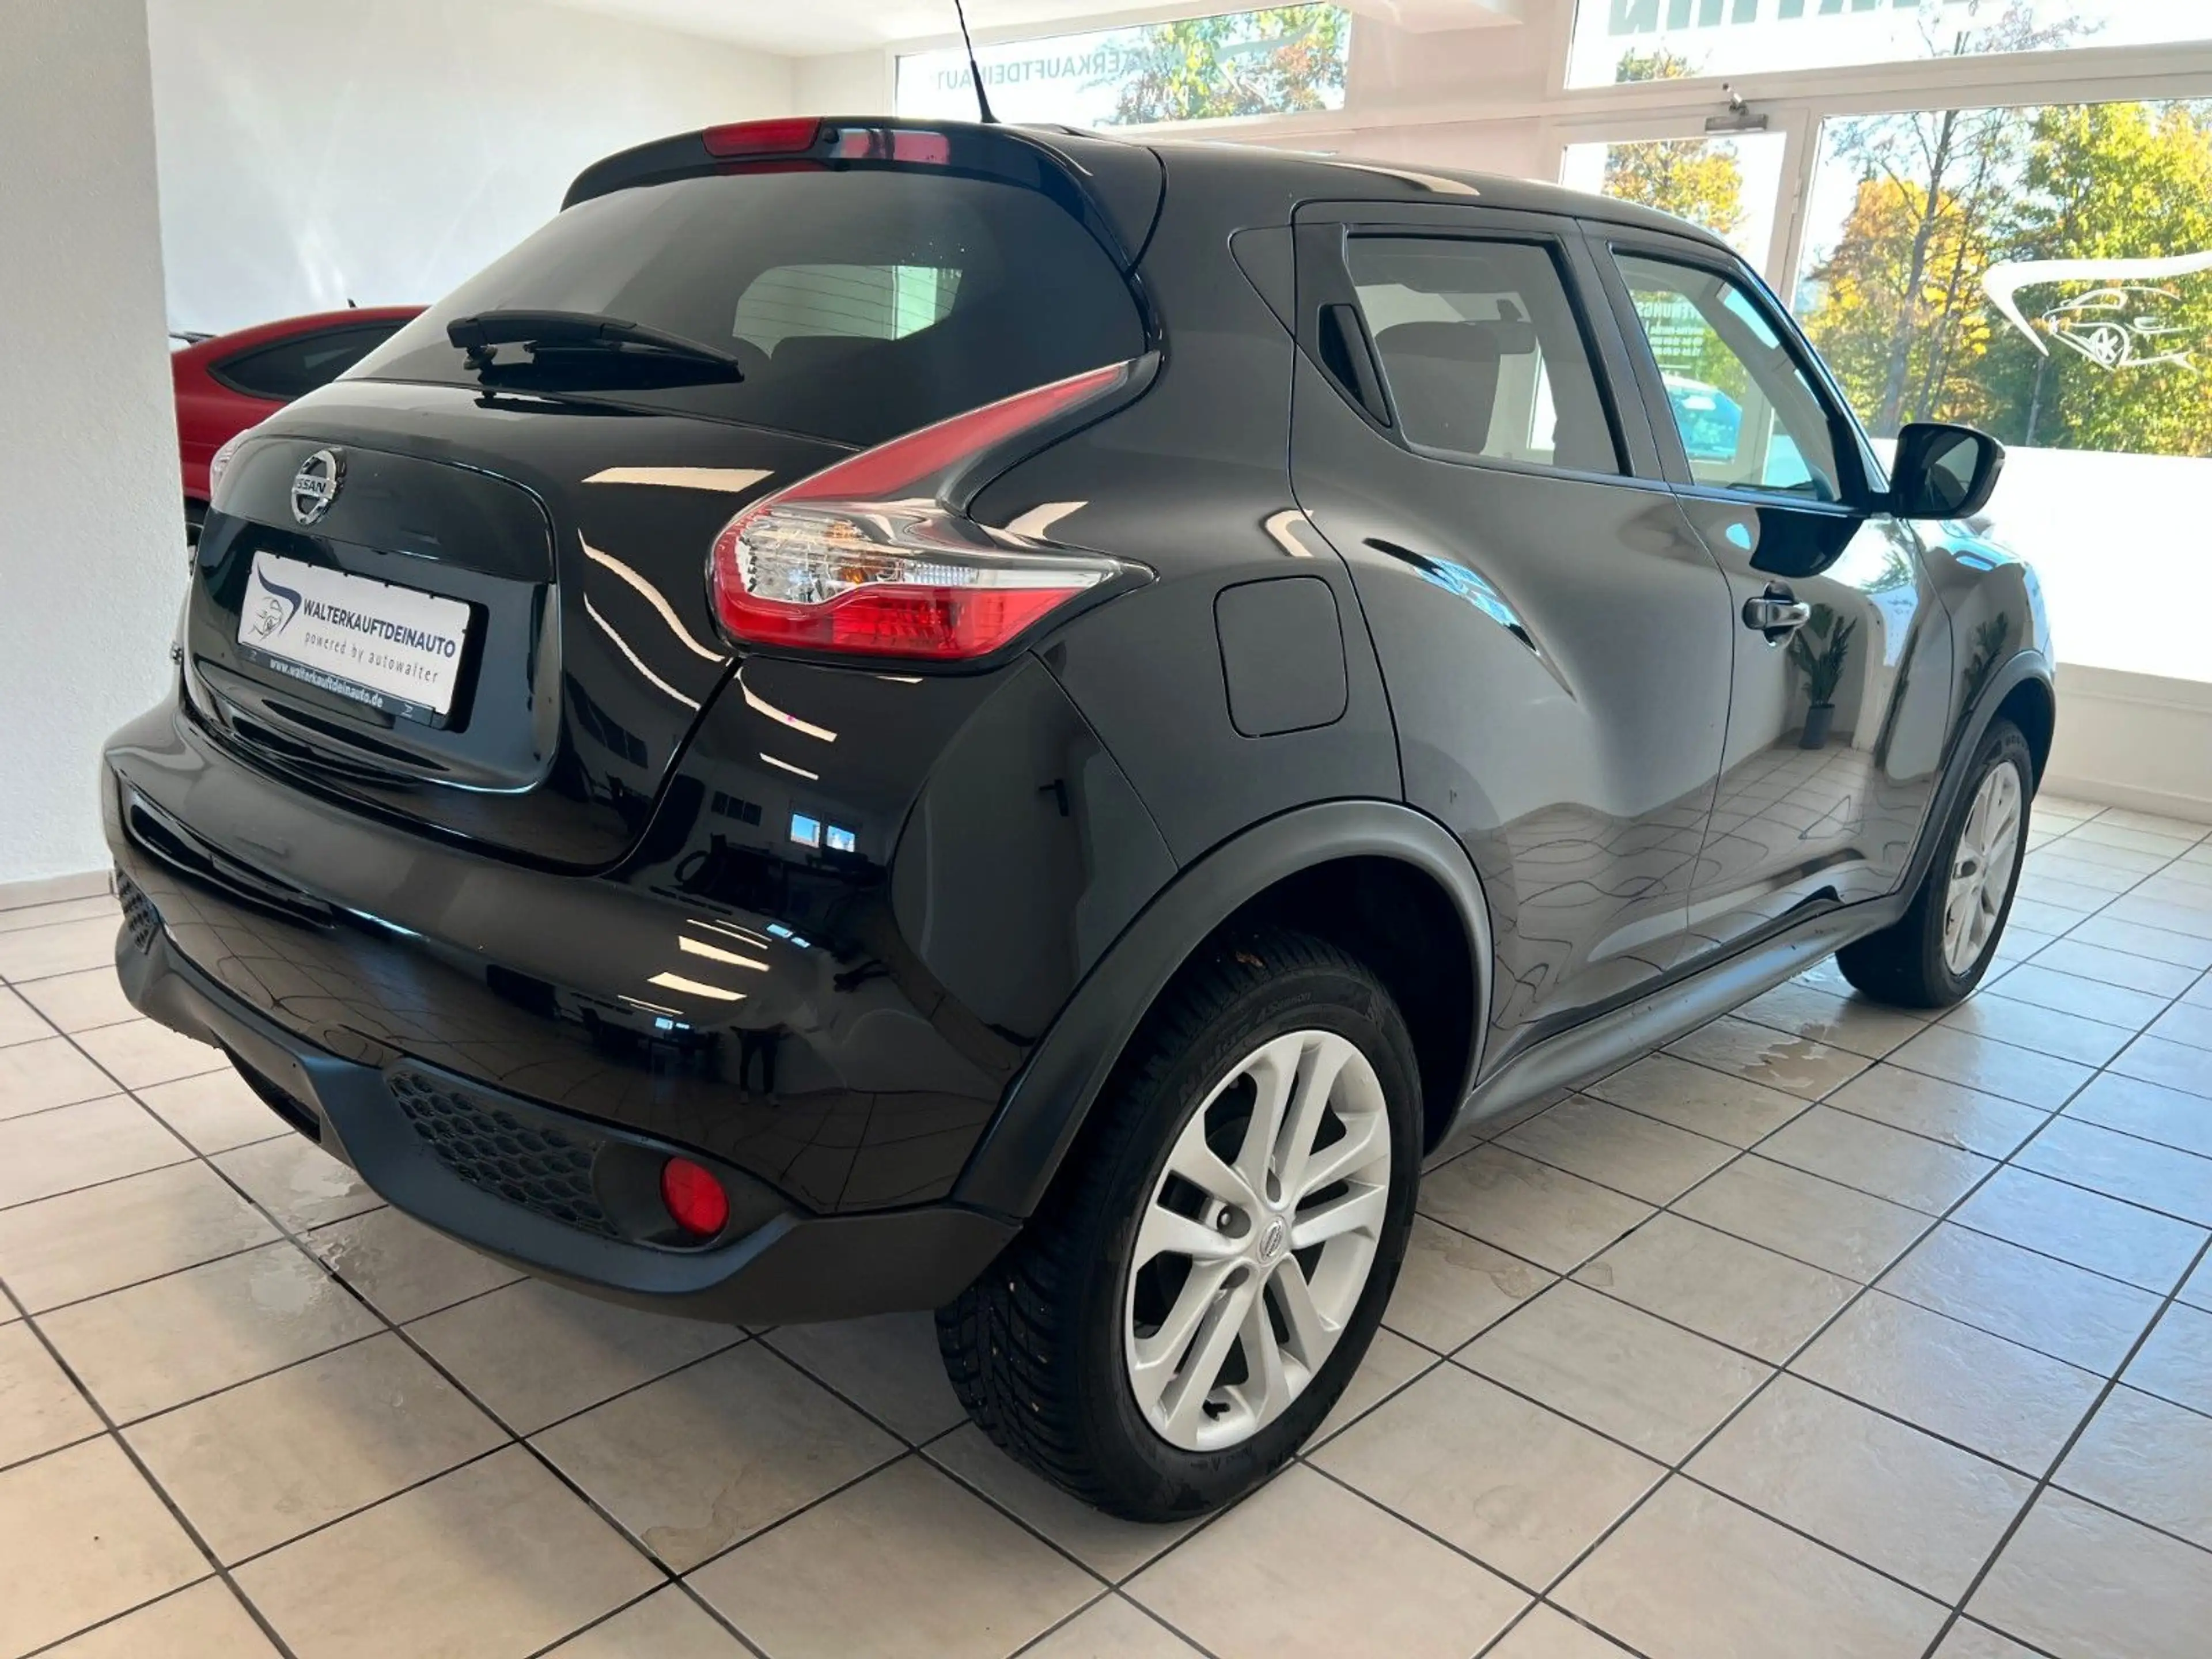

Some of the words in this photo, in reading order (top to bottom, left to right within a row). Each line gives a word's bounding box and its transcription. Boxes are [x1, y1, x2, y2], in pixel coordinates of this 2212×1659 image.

[304, 599, 456, 658] WALTERKAUFTDEINAUTO
[270, 658, 384, 708] www.walterkauftdeinauto.de
[305, 631, 346, 655] powered
[351, 644, 364, 664] by
[368, 652, 438, 683] autowalter
